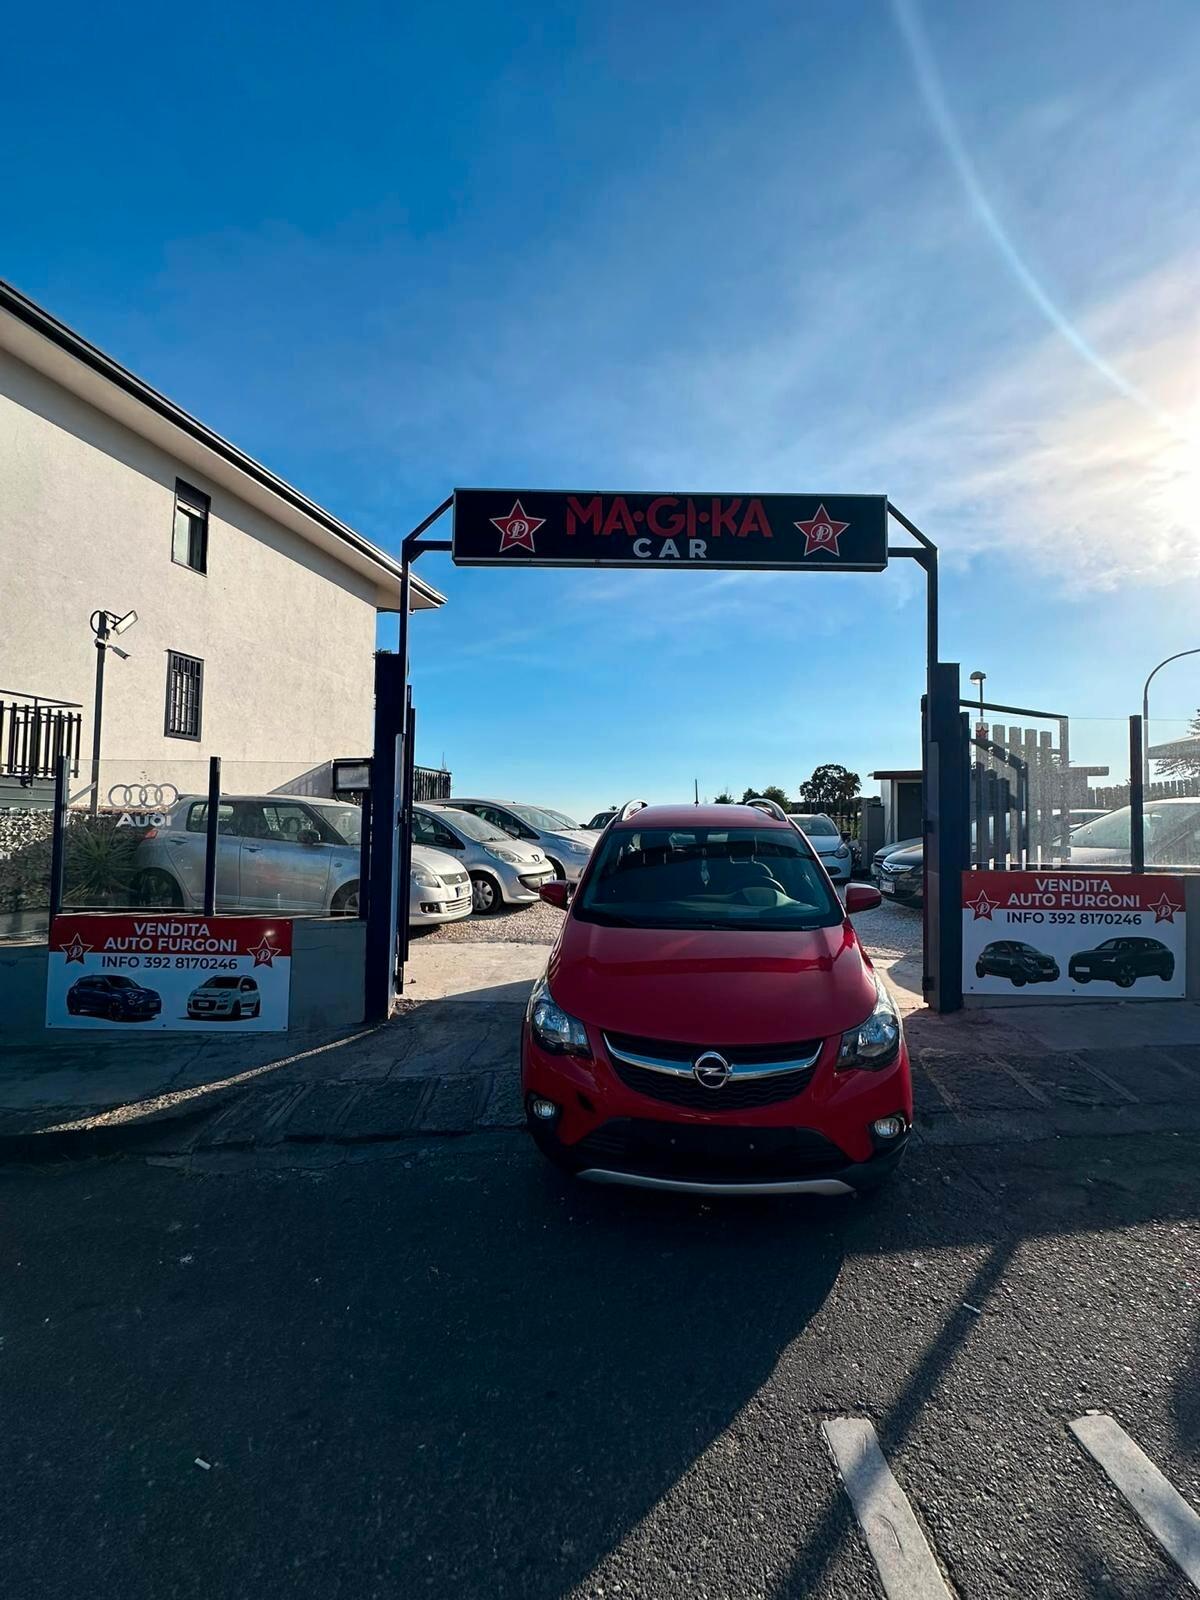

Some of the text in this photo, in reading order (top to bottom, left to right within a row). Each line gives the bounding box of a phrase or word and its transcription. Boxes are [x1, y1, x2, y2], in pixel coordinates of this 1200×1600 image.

[632, 538, 707, 558] CAR
[1036, 878, 1113, 893] VENDITA
[1007, 893, 1140, 908] AUTO FURGONI
[1006, 912, 1142, 926] INFO 392 8170246
[133, 922, 210, 937] VENDITA
[104, 937, 237, 953] AUTO FURGONI
[102, 956, 238, 970] INFO 392 8170246
